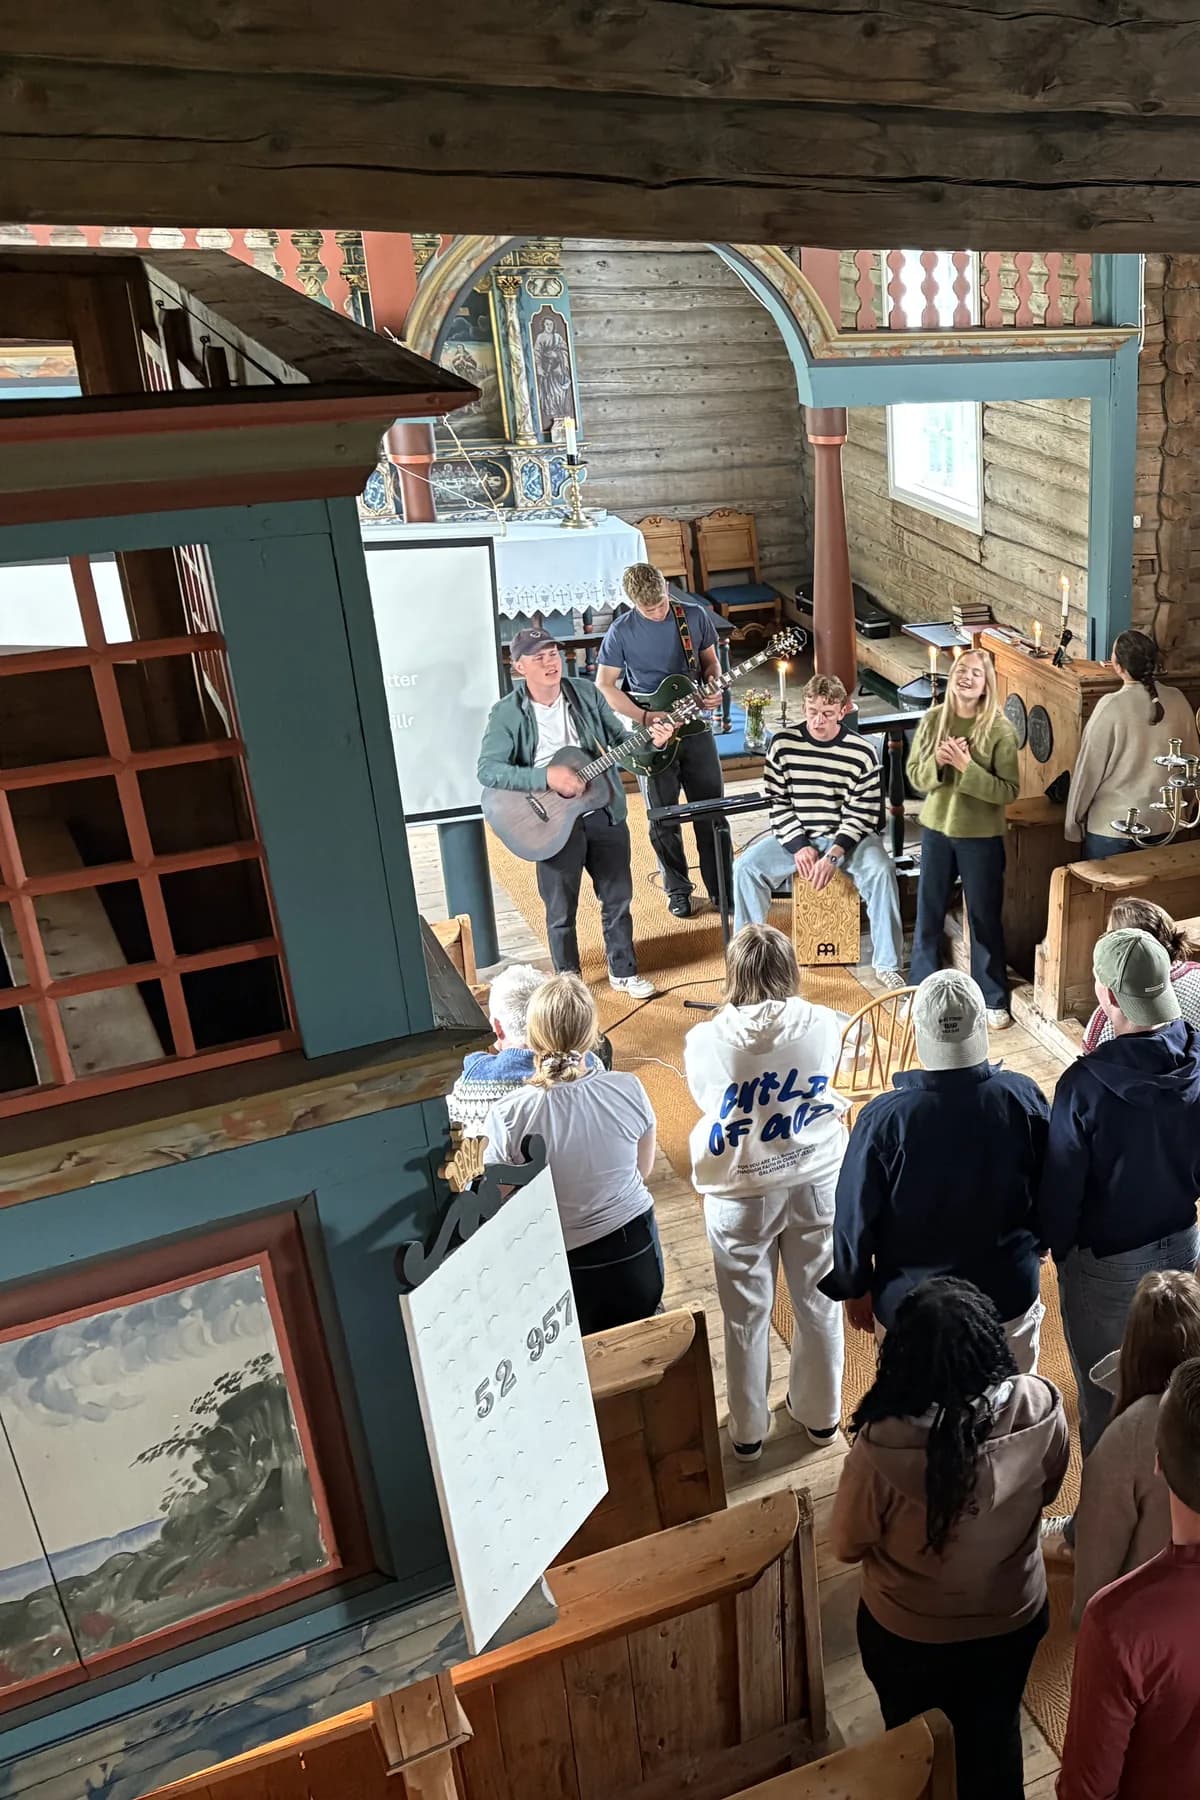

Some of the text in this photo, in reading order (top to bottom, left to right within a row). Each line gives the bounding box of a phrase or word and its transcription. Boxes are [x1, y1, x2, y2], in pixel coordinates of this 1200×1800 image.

[720, 1068, 829, 1120] CHILD
[708, 1102, 835, 1156] OF GOD
[749, 1161, 760, 1169] YOU
[758, 1162, 786, 1176] GALATIANS
[762, 1161, 777, 1170] FAITH
[782, 1153, 800, 1163] CHRIST
